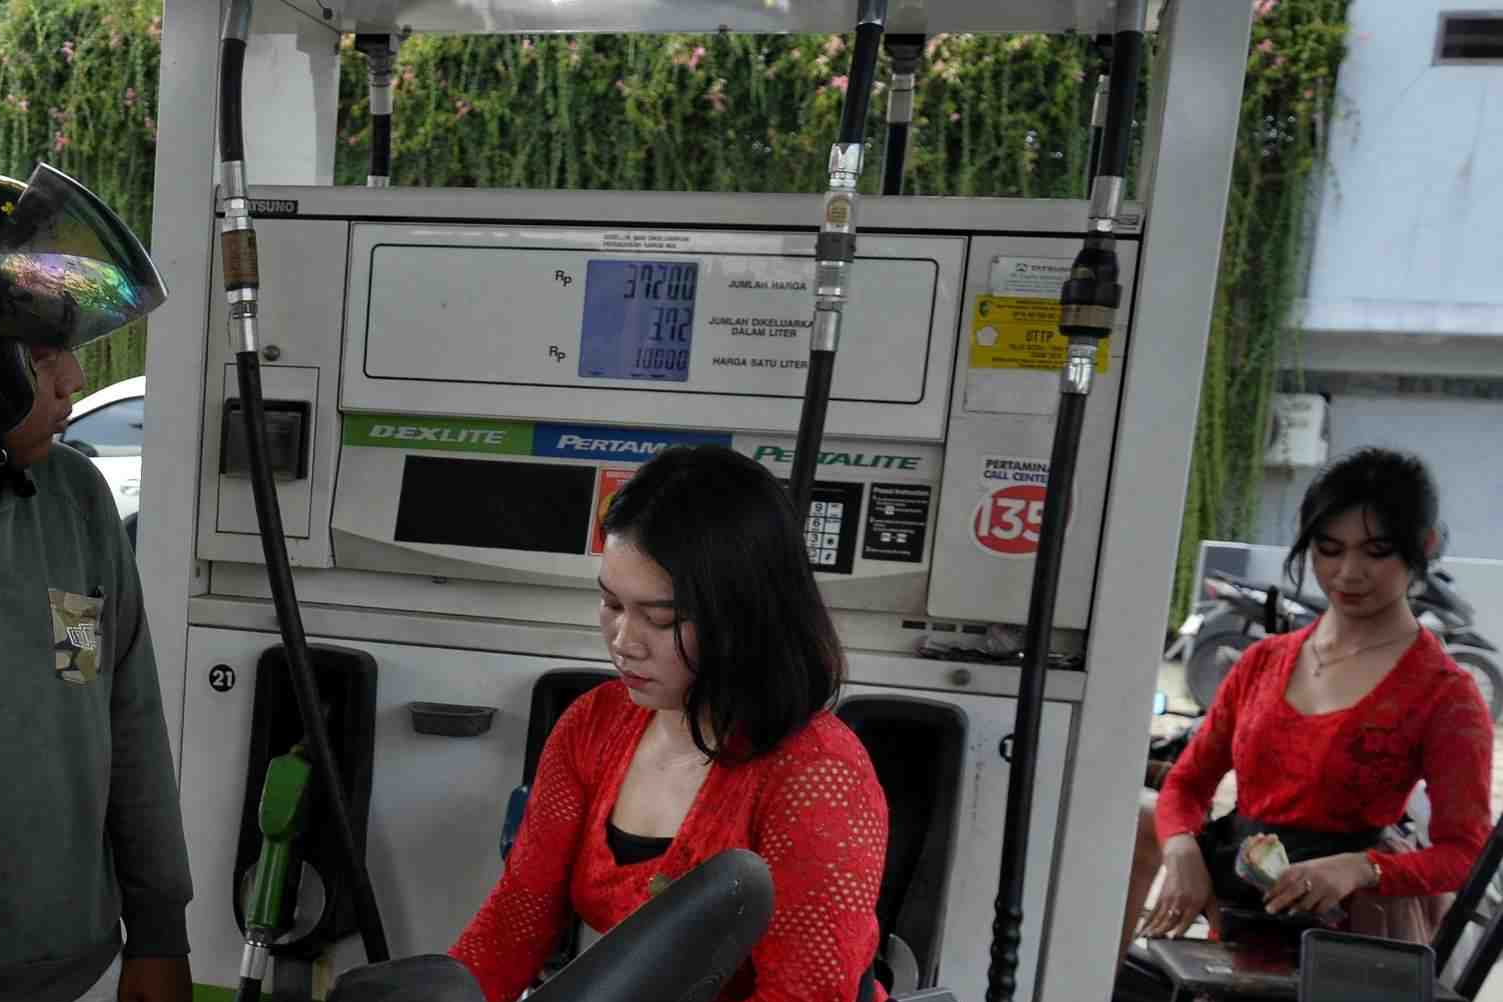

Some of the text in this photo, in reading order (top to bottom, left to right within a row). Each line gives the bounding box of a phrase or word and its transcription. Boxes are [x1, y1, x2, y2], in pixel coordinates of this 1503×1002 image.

[771, 281, 807, 290] HARGA
[751, 318, 814, 328] DIKELUARKA
[731, 327, 797, 337] DALAM LITER
[712, 356, 747, 366] HARGA
[751, 358, 777, 368] SATU
[369, 424, 507, 444] DEXLITE
[557, 435, 666, 453] PERTAM
[754, 446, 923, 470] PETALITE
[984, 470, 1048, 482] CALL CENTE
[212, 670, 233, 688] 21
